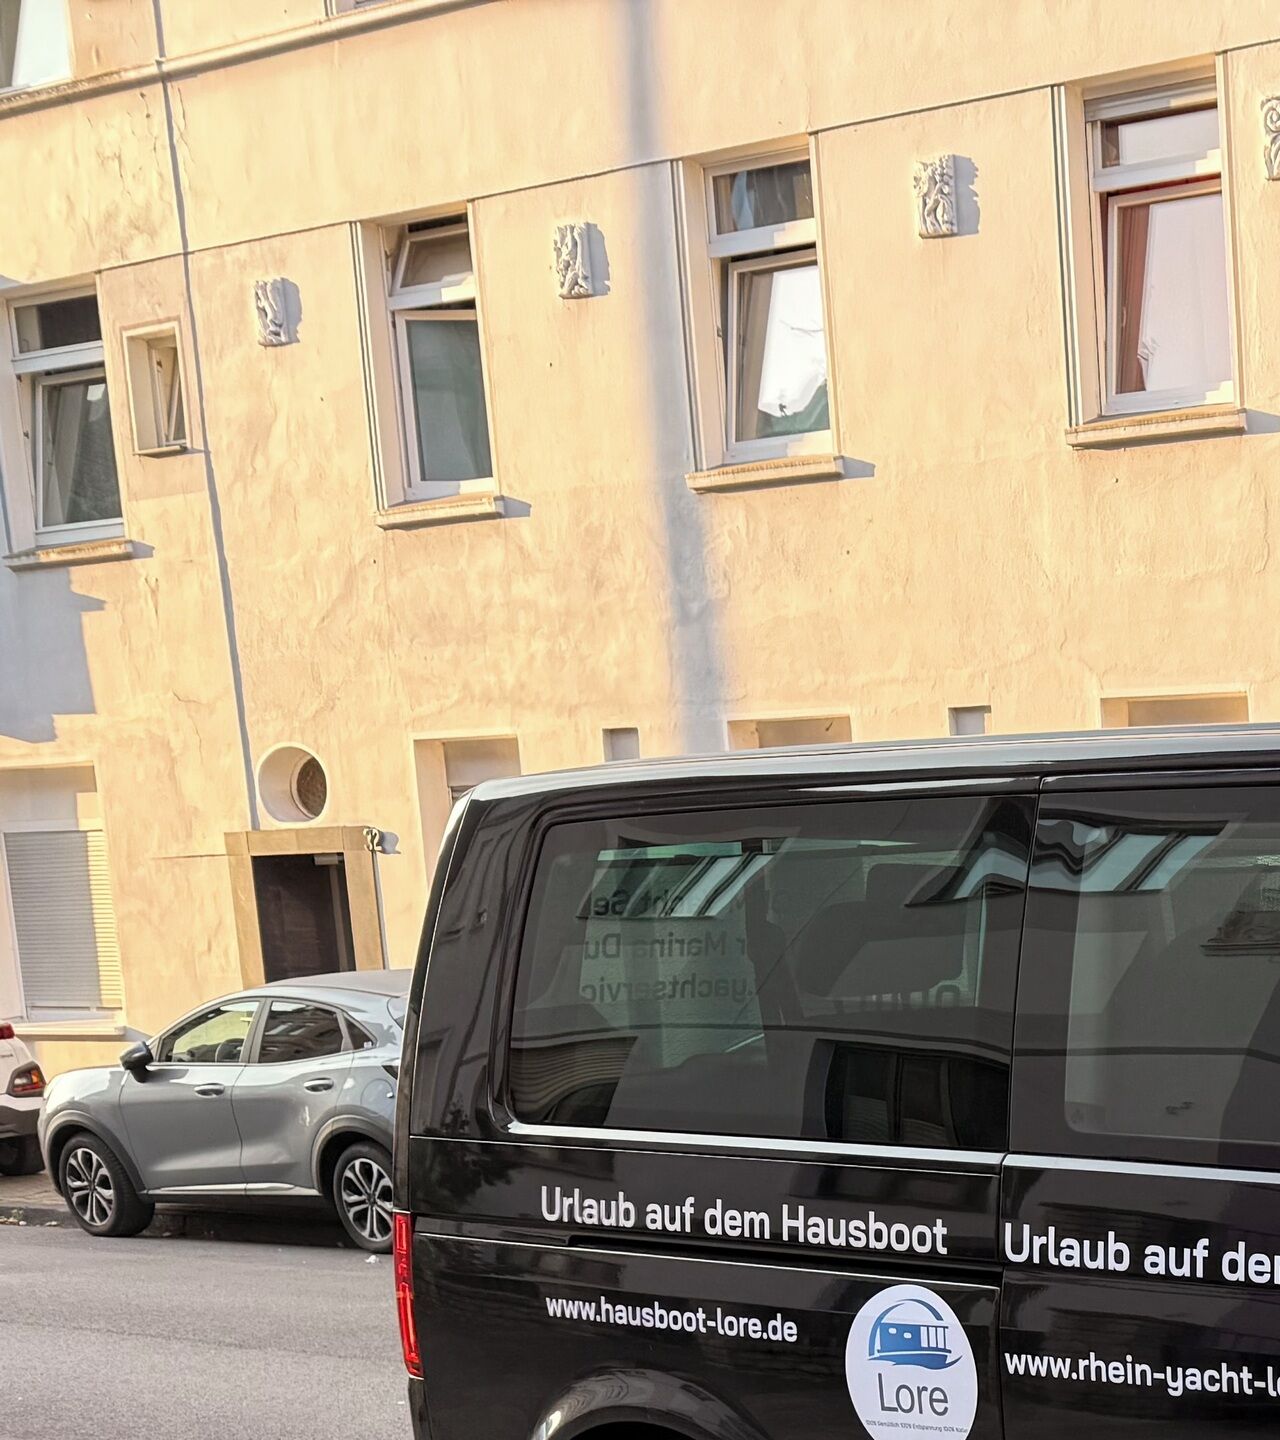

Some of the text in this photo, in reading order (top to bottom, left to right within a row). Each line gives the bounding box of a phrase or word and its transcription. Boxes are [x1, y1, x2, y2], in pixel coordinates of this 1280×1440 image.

[541, 1186, 948, 1255] Urlaub auf dem Hausboot
[1004, 1222, 1130, 1272] Urlaub
[1143, 1239, 1210, 1278] auf
[545, 1296, 798, 1343] www.hausboot-lore.de
[877, 1372, 949, 1417] Lore
